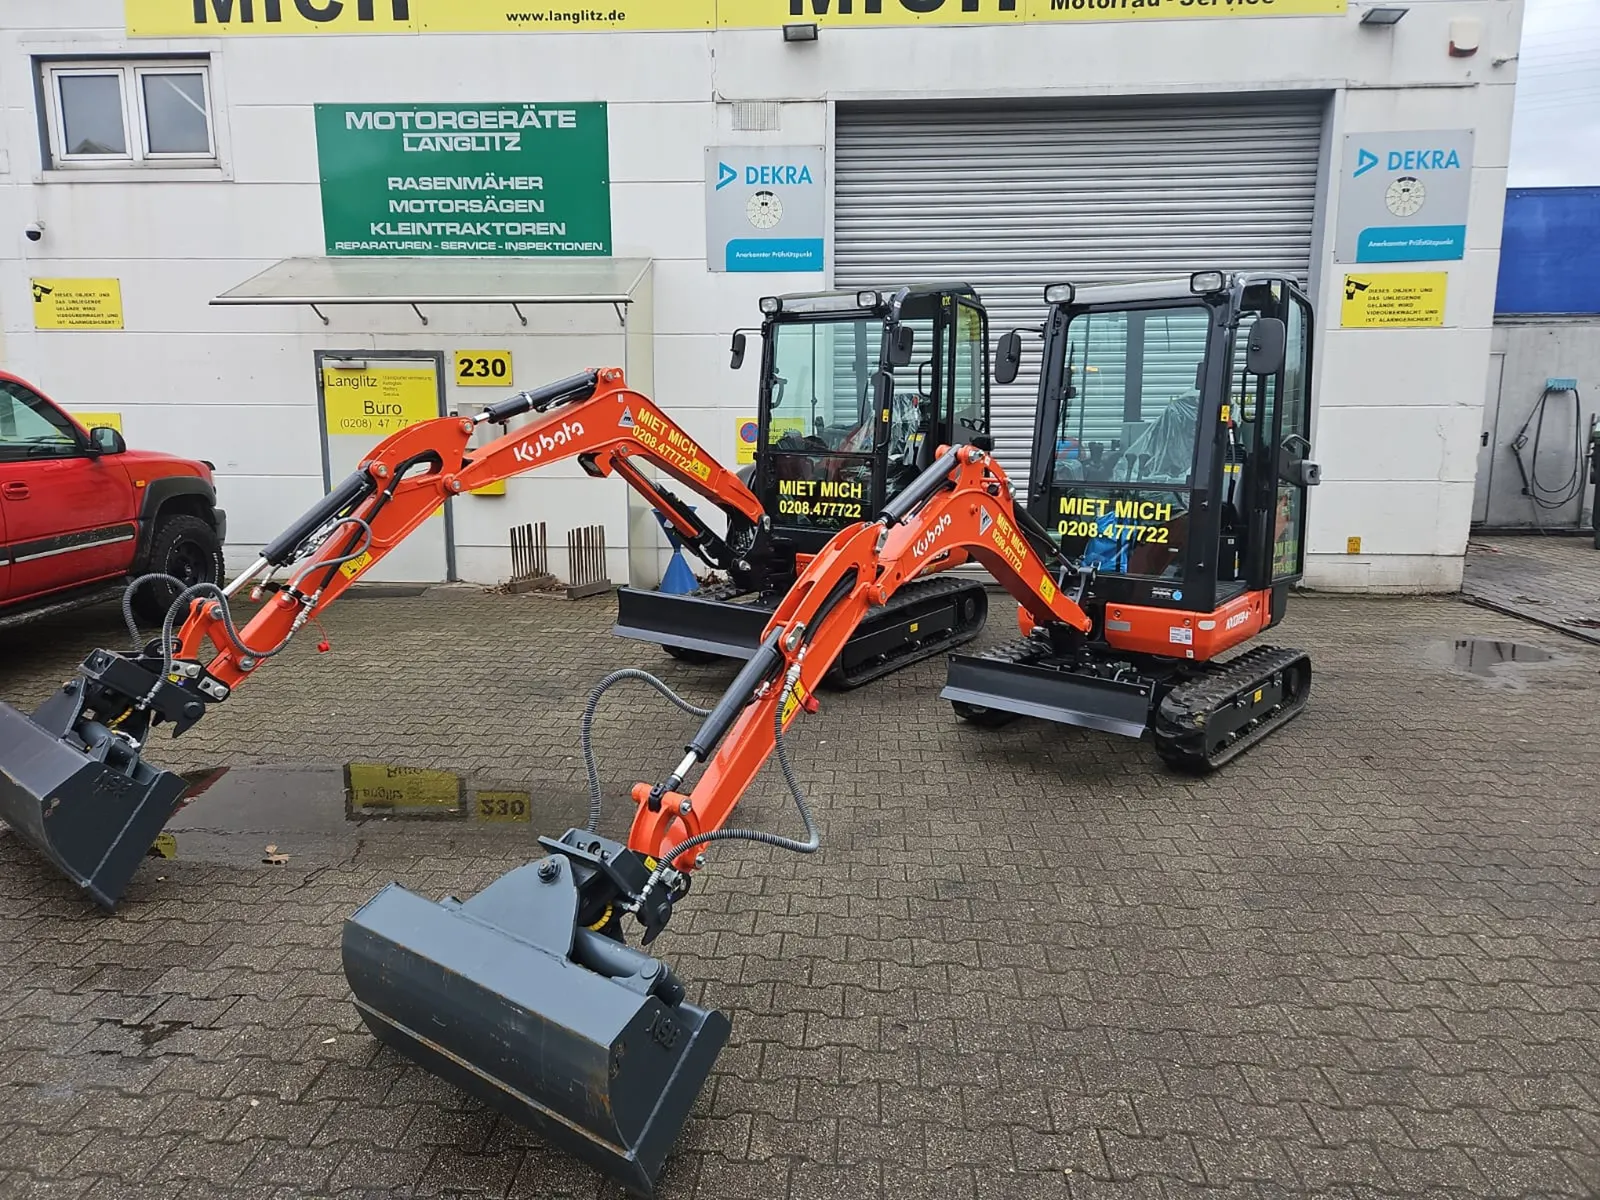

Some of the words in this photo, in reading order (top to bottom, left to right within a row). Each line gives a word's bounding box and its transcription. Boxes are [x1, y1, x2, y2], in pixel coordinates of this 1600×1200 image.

[505, 9, 626, 25] www.langlitz.de
[345, 104, 577, 130] MOTORGERÄTE
[402, 132, 521, 152] LANGLITZ
[1387, 149, 1461, 171] DEKRA
[387, 172, 544, 190] RASENMÄHER
[745, 165, 813, 185] DEKRA
[388, 195, 545, 213] MOTORSÄGEN
[370, 222, 567, 236] KLEINTRAKTOREN
[335, 241, 433, 250] REPARATUREN
[440, 241, 497, 250] SERVICE
[504, 241, 603, 251] INSPEKTIONEN
[459, 358, 506, 377] 230
[327, 374, 378, 390] Langlitz
[363, 400, 403, 416] Büro
[340, 418, 372, 429] (0208)
[377, 418, 390, 428] 47
[396, 418, 409, 428] 77
[637, 407, 669, 436] MIET
[667, 428, 699, 458] MICH
[513, 421, 585, 462] Kubota
[632, 424, 691, 472] 0208.477722
[779, 480, 817, 497] MIET
[820, 482, 862, 499] MICH
[779, 500, 862, 518] 0208.477722
[1059, 497, 1110, 517] MIET
[1114, 500, 1172, 522] MICH
[912, 513, 952, 558] Kubota
[996, 512, 1013, 539] MIET
[1010, 532, 1028, 560] MICH
[1057, 520, 1169, 544] 0208.477722
